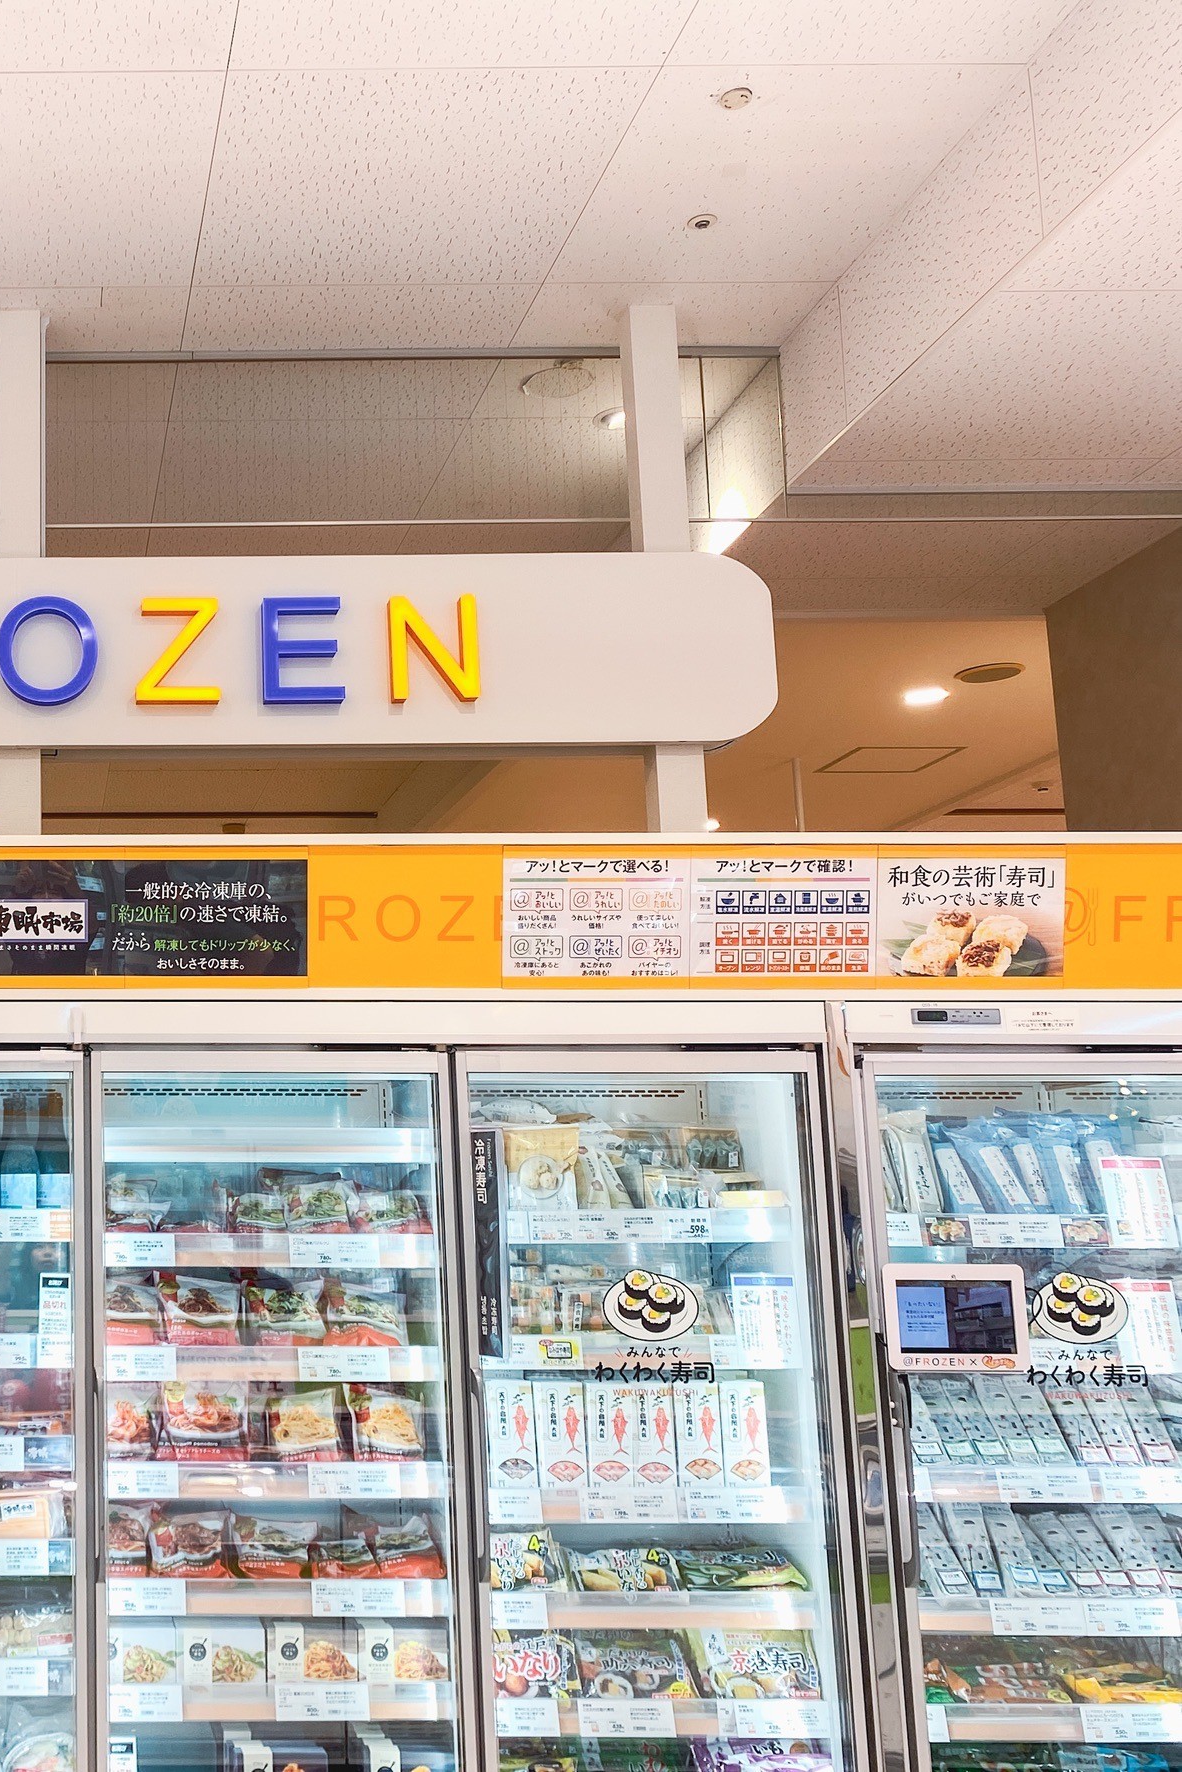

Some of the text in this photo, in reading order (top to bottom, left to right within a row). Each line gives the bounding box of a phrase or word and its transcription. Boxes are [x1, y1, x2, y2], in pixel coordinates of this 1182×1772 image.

[887, 864, 1056, 888] 和食の芸術「寿司」
[125, 881, 273, 900] 一般的な冷凍庫の、
[901, 891, 1042, 907] がいつでもご家庭で
[156, 957, 246, 971] おいしさそのまま。
[689, 1225, 705, 1234] 598
[626, 1346, 682, 1358] みんなで
[1058, 1349, 1113, 1361] みんなで
[595, 1361, 715, 1384] わくわく寿司
[1026, 1364, 1149, 1388] わくわく寿司
